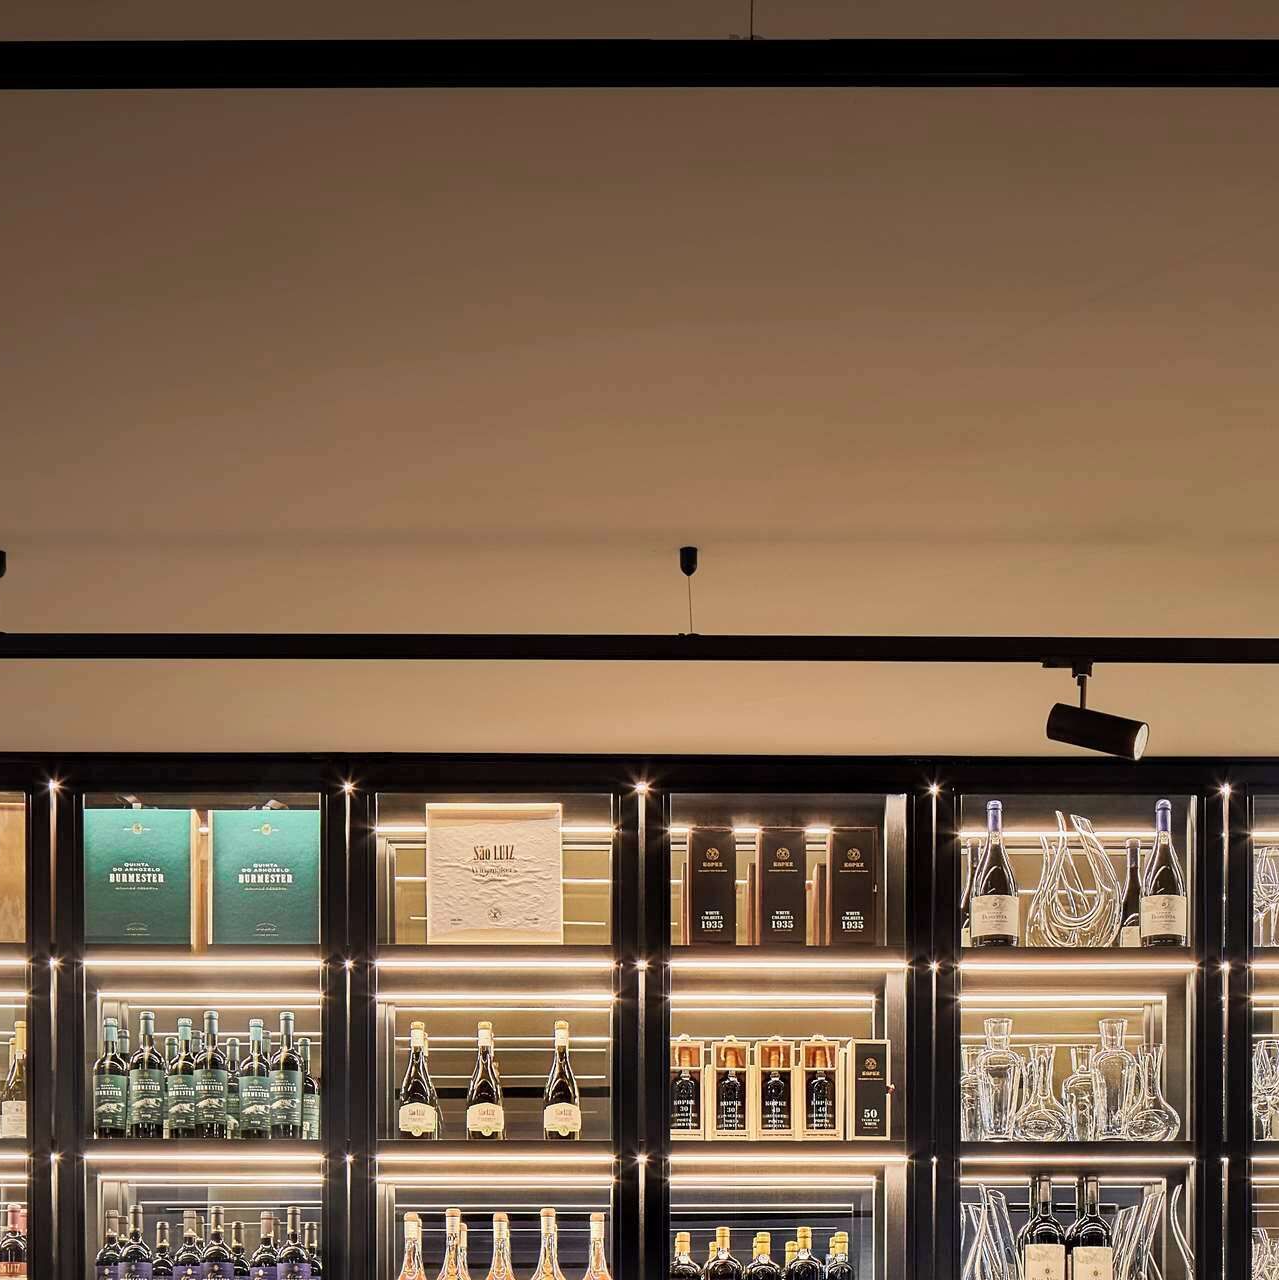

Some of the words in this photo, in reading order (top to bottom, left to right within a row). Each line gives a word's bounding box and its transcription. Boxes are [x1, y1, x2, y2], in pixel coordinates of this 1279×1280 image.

[473, 845, 491, 861] São
[494, 845, 514, 861] LUIZ
[109, 873, 164, 883] BURMESTER
[238, 874, 293, 884] BURMESTER
[701, 921, 723, 929] 1935
[772, 921, 794, 929] 1935
[842, 921, 864, 929] 1935
[864, 1109, 877, 1118] 50
